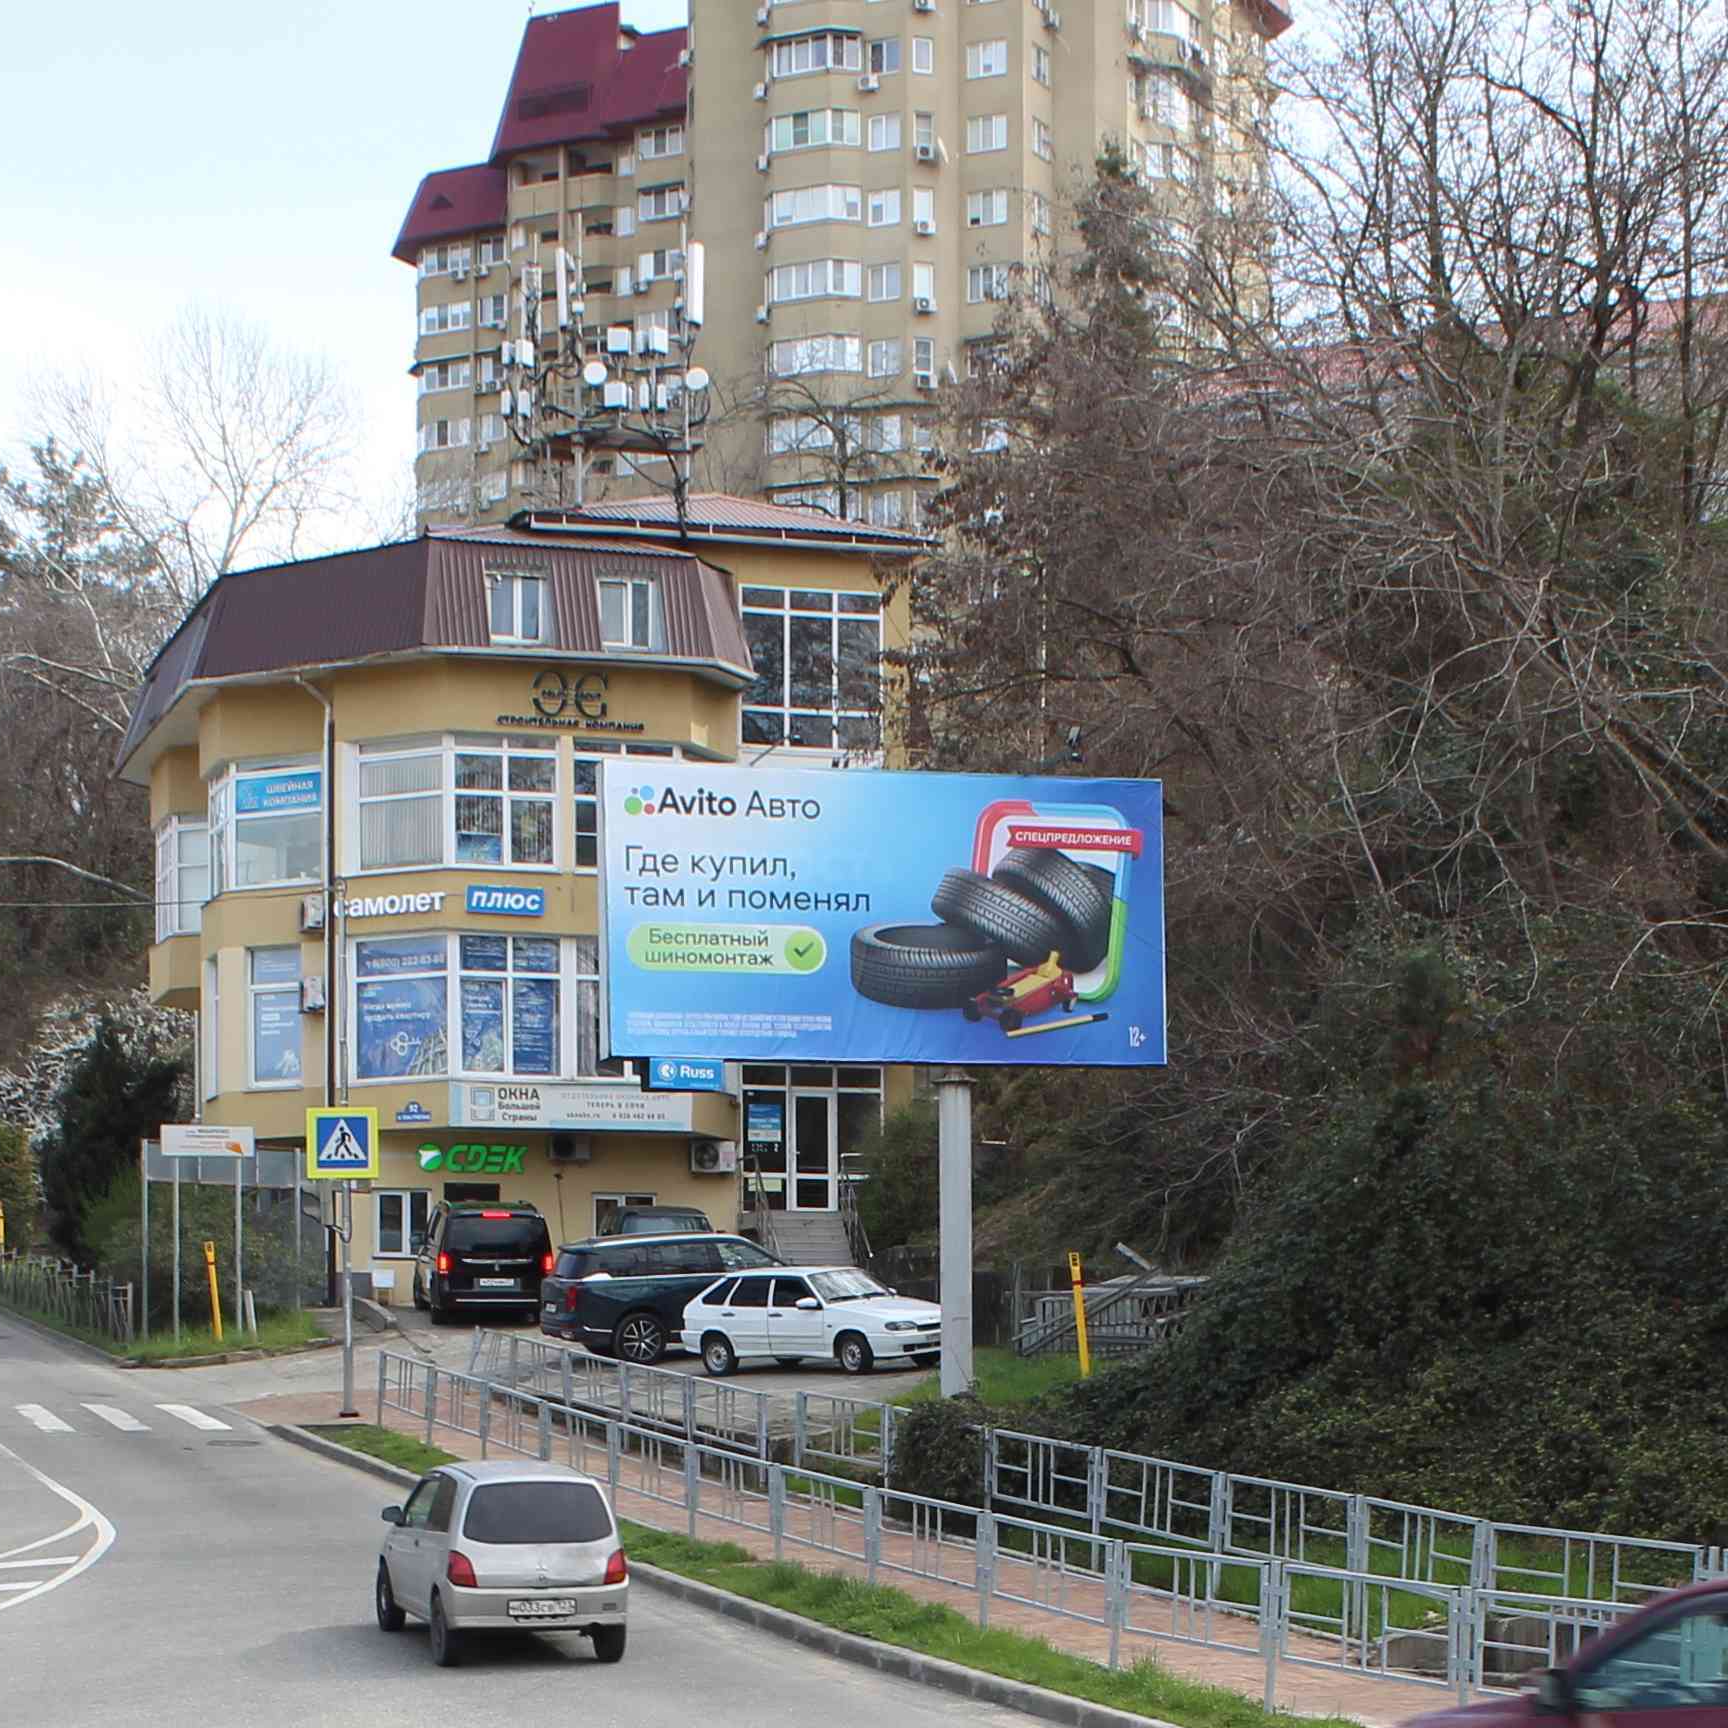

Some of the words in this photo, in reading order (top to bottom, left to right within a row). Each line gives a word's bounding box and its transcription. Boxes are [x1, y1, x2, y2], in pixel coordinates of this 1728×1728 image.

[586, 719, 645, 731] КОМПАНИЯ
[658, 787, 736, 816] Avito
[745, 790, 821, 819] Авто
[1015, 830, 1132, 847] СПЕЦПРЕДЛОЖЕНИЕ
[624, 846, 679, 877] Где
[691, 852, 797, 880] купил,
[334, 892, 446, 917] самолет
[471, 890, 542, 911] плюс
[624, 887, 685, 908] там
[697, 889, 716, 908] и
[728, 889, 871, 913] поменял
[648, 928, 770, 948] Бесплатный
[644, 948, 774, 967] шиномонтаж
[1129, 1026, 1147, 1047] 12+
[680, 1065, 715, 1080] Russ
[498, 1087, 540, 1101] ОКНА
[502, 1111, 537, 1122] Страны
[445, 1142, 529, 1174] CDEK
